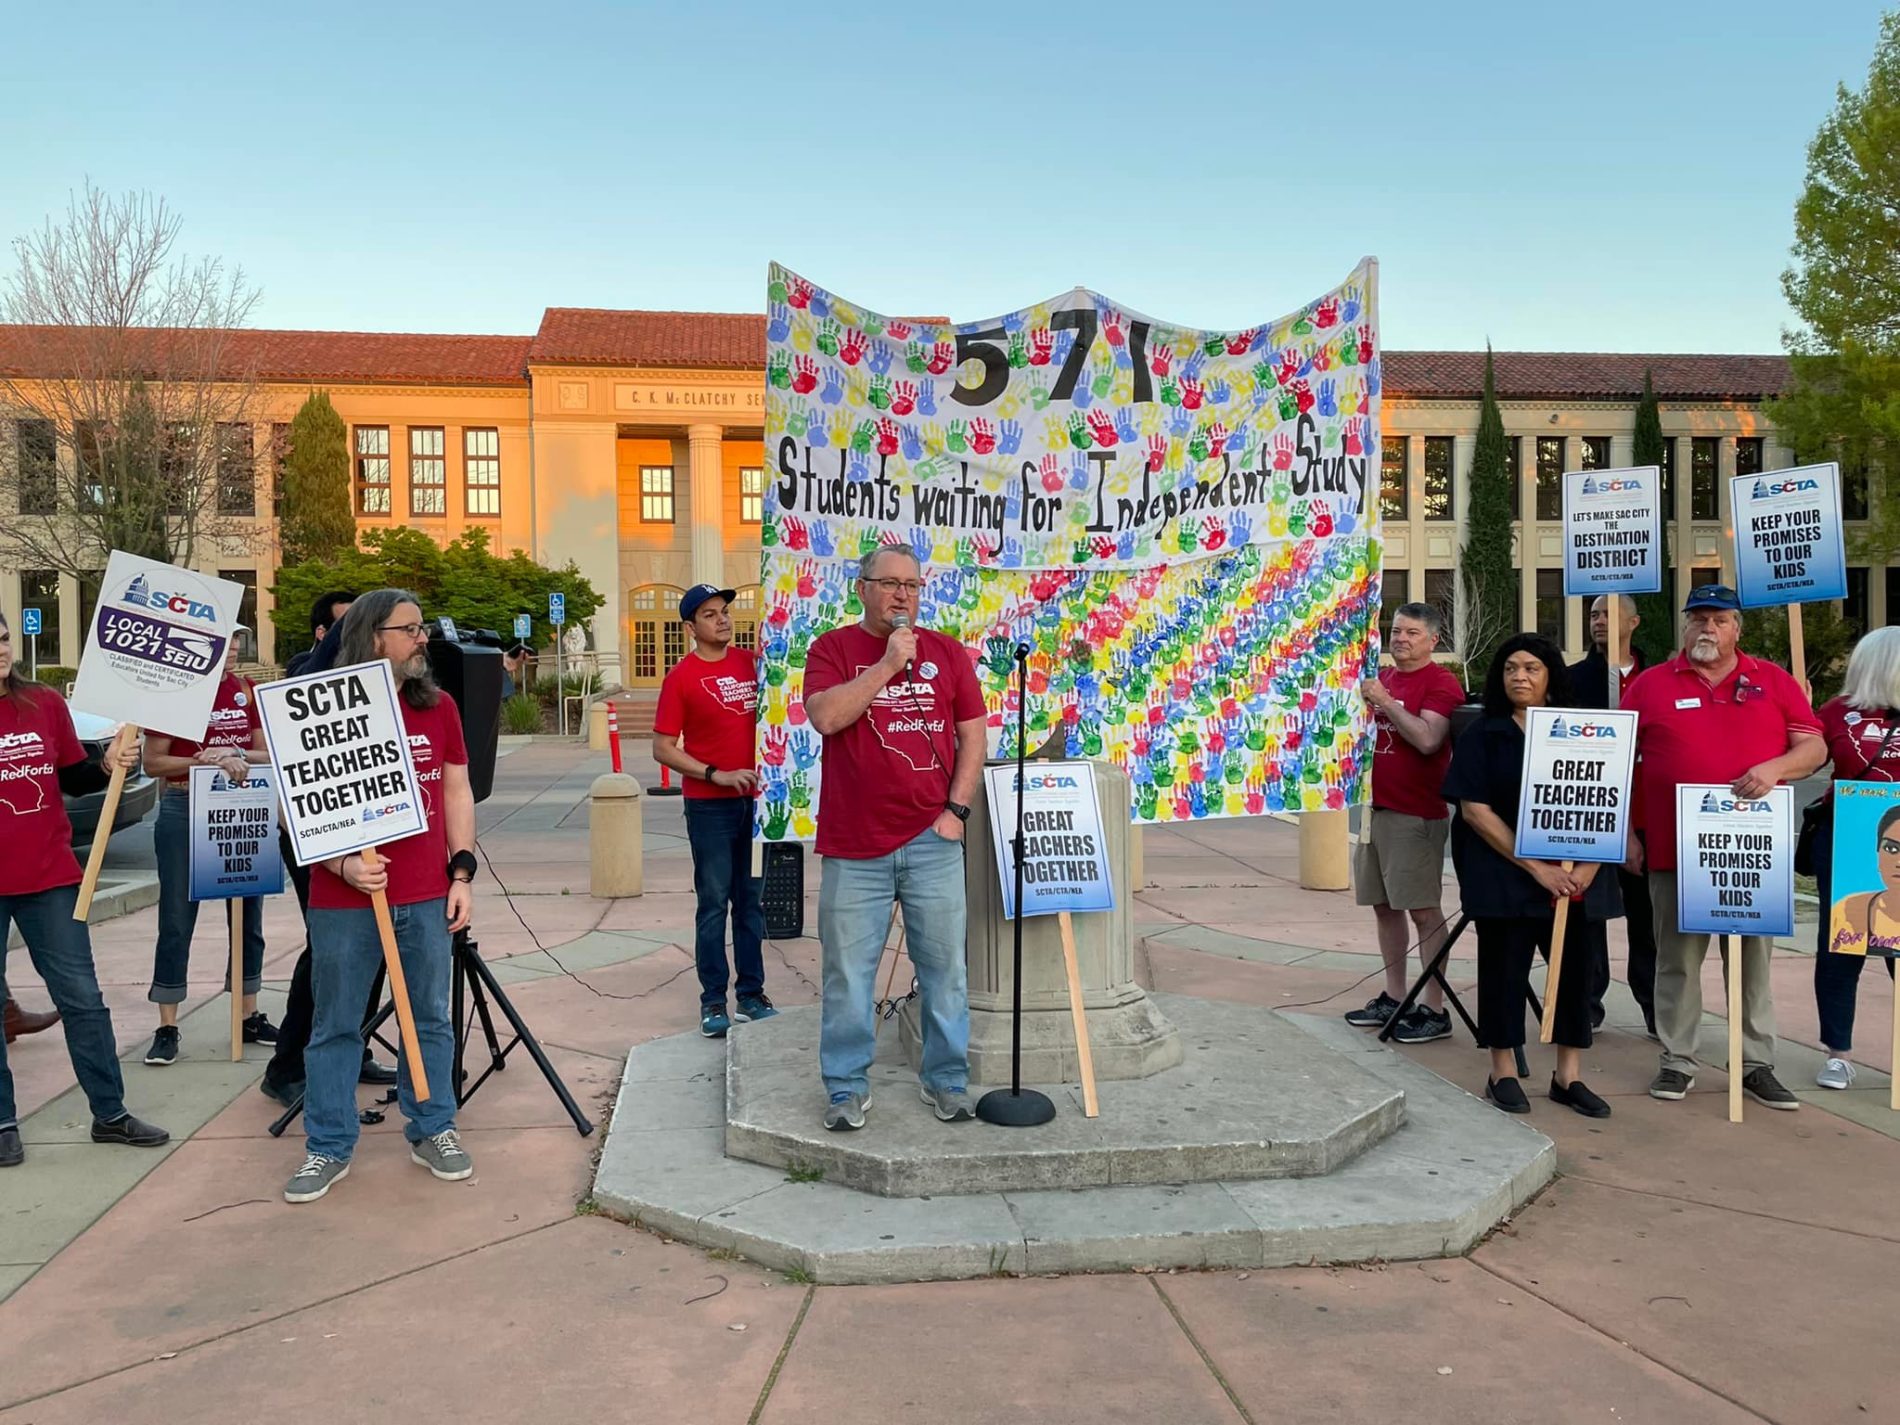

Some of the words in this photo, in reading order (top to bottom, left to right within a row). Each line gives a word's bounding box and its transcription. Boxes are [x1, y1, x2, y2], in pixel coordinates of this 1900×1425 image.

[950, 309, 1153, 406] 571
[777, 436, 901, 522] Students
[912, 462, 1007, 557] waiting
[1021, 461, 1062, 532] for
[1085, 442, 1272, 540] Independent
[1291, 413, 1367, 514] Study
[1598, 479, 1642, 492] SCTA
[1768, 479, 1819, 495] SCTA
[1573, 512, 1592, 522] LET'S
[1593, 510, 1615, 521] MAKE
[1615, 509, 1631, 519] SAC
[1632, 508, 1650, 519] CITY
[1751, 514, 1783, 532] KEEP
[1785, 509, 1821, 527] YOUR
[1604, 520, 1619, 530] THE
[1574, 530, 1650, 548] DESTINATION
[1753, 526, 1821, 548] PROMISES
[1577, 549, 1648, 569] DISTRICT
[1764, 548, 1782, 564] TO
[1784, 544, 1812, 561] OUR
[1773, 562, 1806, 580] KIDS
[150, 591, 217, 623] SCTA
[106, 614, 164, 641] LOCAL
[104, 628, 162, 656] 1021
[109, 653, 143, 667] CLASSIFIED
[161, 650, 209, 671] SEIU
[285, 675, 371, 721] SCTA
[888, 682, 936, 698] SCTA
[301, 714, 370, 751] GREAT
[1569, 724, 1617, 738] SCTA
[283, 740, 400, 788] TEACHERS
[1552, 759, 1605, 782] GREAT
[228, 777, 269, 789] SCTA
[1030, 775, 1078, 789] SCTA
[291, 770, 408, 819] TOGETHER
[1533, 784, 1619, 808] TEACHERS
[208, 809, 236, 824] KEEP
[238, 807, 269, 823] YOUR
[375, 802, 411, 816] SCTA
[1720, 800, 1773, 813] SCTA
[300, 818, 356, 839] SCTA/CTA/NEA
[1023, 810, 1074, 832] GREAT
[1531, 808, 1617, 833] TOGETHER
[208, 824, 268, 841] PROMISES
[217, 841, 232, 857] TO
[235, 840, 259, 856] OUR
[1698, 833, 1731, 849] KEEP
[1735, 833, 1773, 851] YOUR
[224, 858, 252, 873] KIDS
[1699, 851, 1772, 870] PROMISES
[1012, 860, 1099, 884] OGETHER
[1710, 871, 1728, 888] TO
[1731, 872, 1760, 888] OUR
[1036, 887, 1083, 896] SCTA/CTA/NEA
[1718, 890, 1753, 907] KIDS
